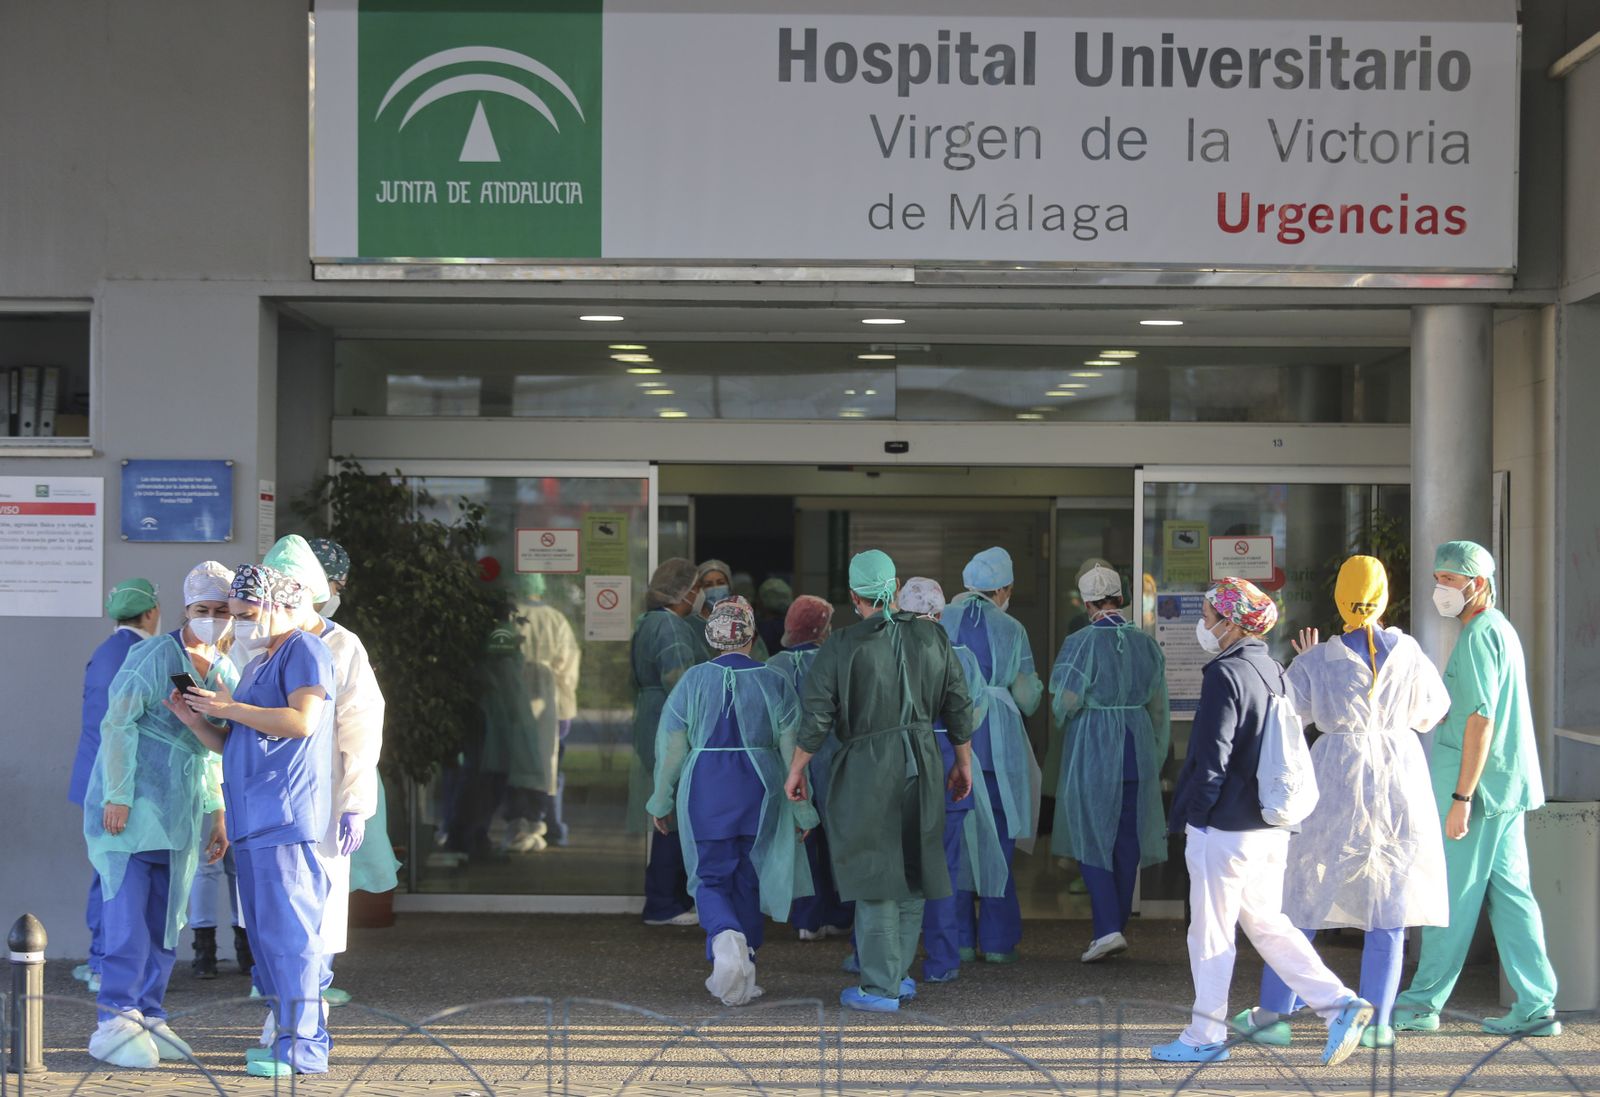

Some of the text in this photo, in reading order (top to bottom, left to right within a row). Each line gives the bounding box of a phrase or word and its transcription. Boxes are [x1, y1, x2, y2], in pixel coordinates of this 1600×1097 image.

[777, 28, 1471, 97] Hospital Universitario
[869, 114, 1470, 171] Virgen de la Victoria
[376, 181, 583, 205] JUNTA DE ANDALUCIA
[868, 192, 1468, 244] de Málaga Urgencias
